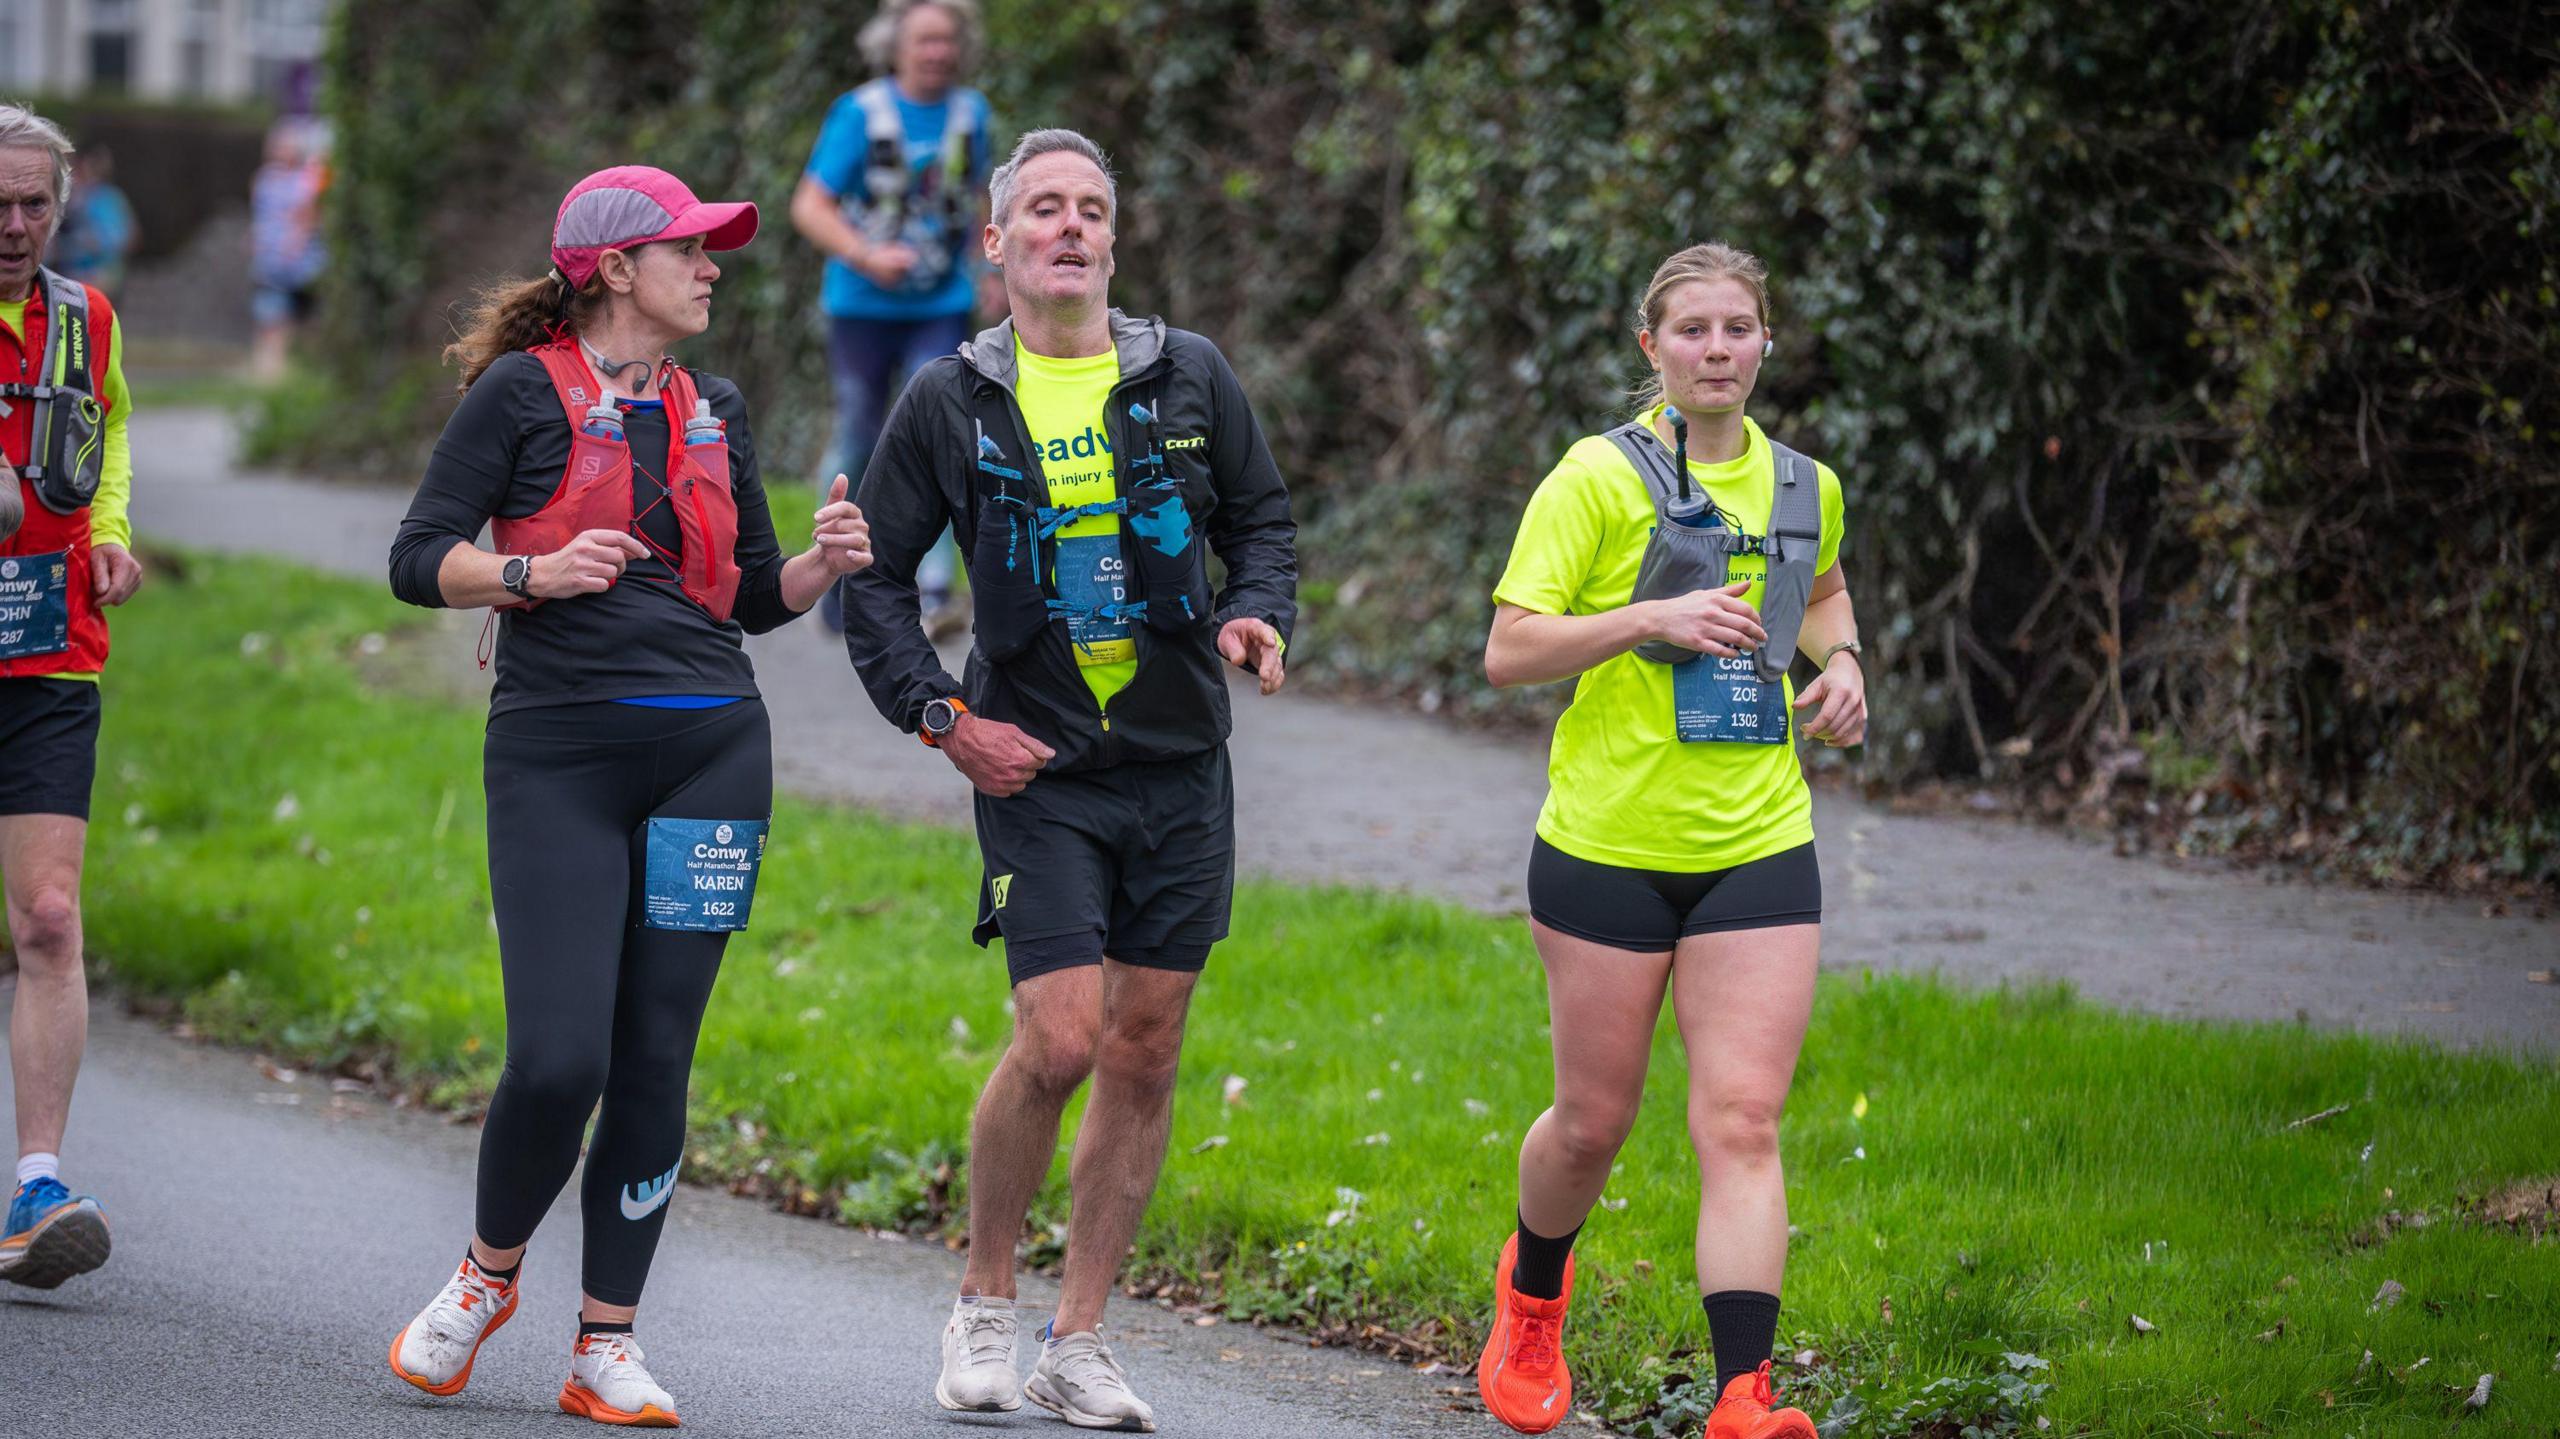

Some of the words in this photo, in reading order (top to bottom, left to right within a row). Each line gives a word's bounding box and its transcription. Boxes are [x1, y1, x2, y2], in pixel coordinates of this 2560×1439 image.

[1165, 436, 1205, 450] COTT
[1048, 478, 1057, 487] n
[1061, 471, 1101, 486] injury
[1094, 574, 1109, 582] Half
[1727, 570, 1751, 583] jury
[0, 606, 32, 621] OHN
[1113, 614, 1129, 625] 12
[0, 629, 24, 644] 287
[1719, 657, 1754, 670] Con
[1730, 673, 1756, 681] Maratho
[1732, 687, 1758, 703] ZOE
[1731, 713, 1758, 728] 1302
[694, 843, 748, 862] Conwy
[687, 861, 702, 869] Half
[704, 862, 735, 870] Marathon
[737, 862, 751, 871] 2025
[694, 875, 745, 890] KAREN
[702, 902, 735, 915] 1622
